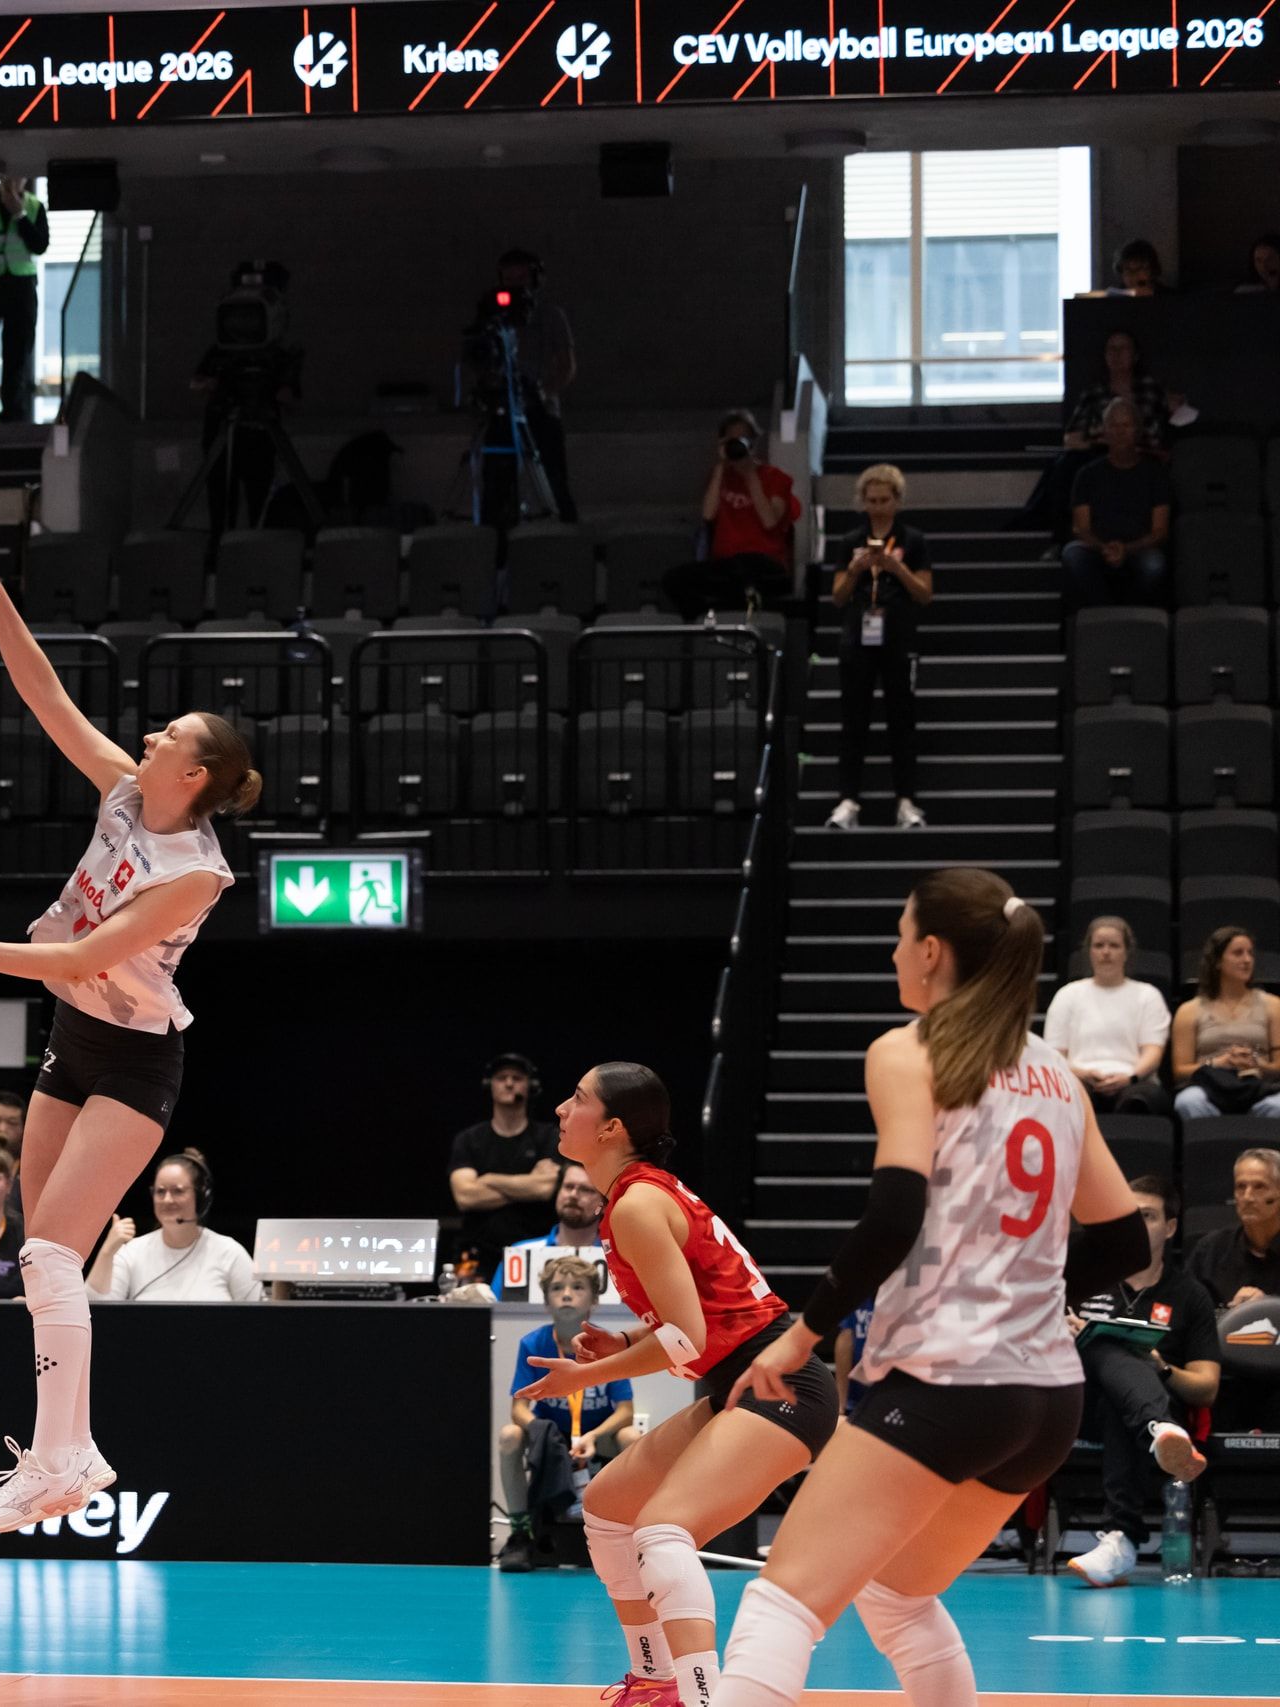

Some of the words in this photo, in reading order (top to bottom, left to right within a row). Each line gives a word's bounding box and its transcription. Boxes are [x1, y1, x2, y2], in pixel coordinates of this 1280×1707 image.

[403, 41, 500, 74] Kriens
[673, 33, 740, 65] CEV
[744, 26, 897, 67] Volleyball
[905, 28, 1054, 62] European
[1062, 23, 1179, 58] League
[1186, 17, 1264, 49] 2026
[43, 57, 154, 91] League
[159, 51, 234, 82] 2026
[1000, 1117, 1056, 1240] 9
[509, 1255, 523, 1284] 0
[639, 1636, 654, 1665] CRAFT
[693, 1666, 710, 1699] CRAFT
